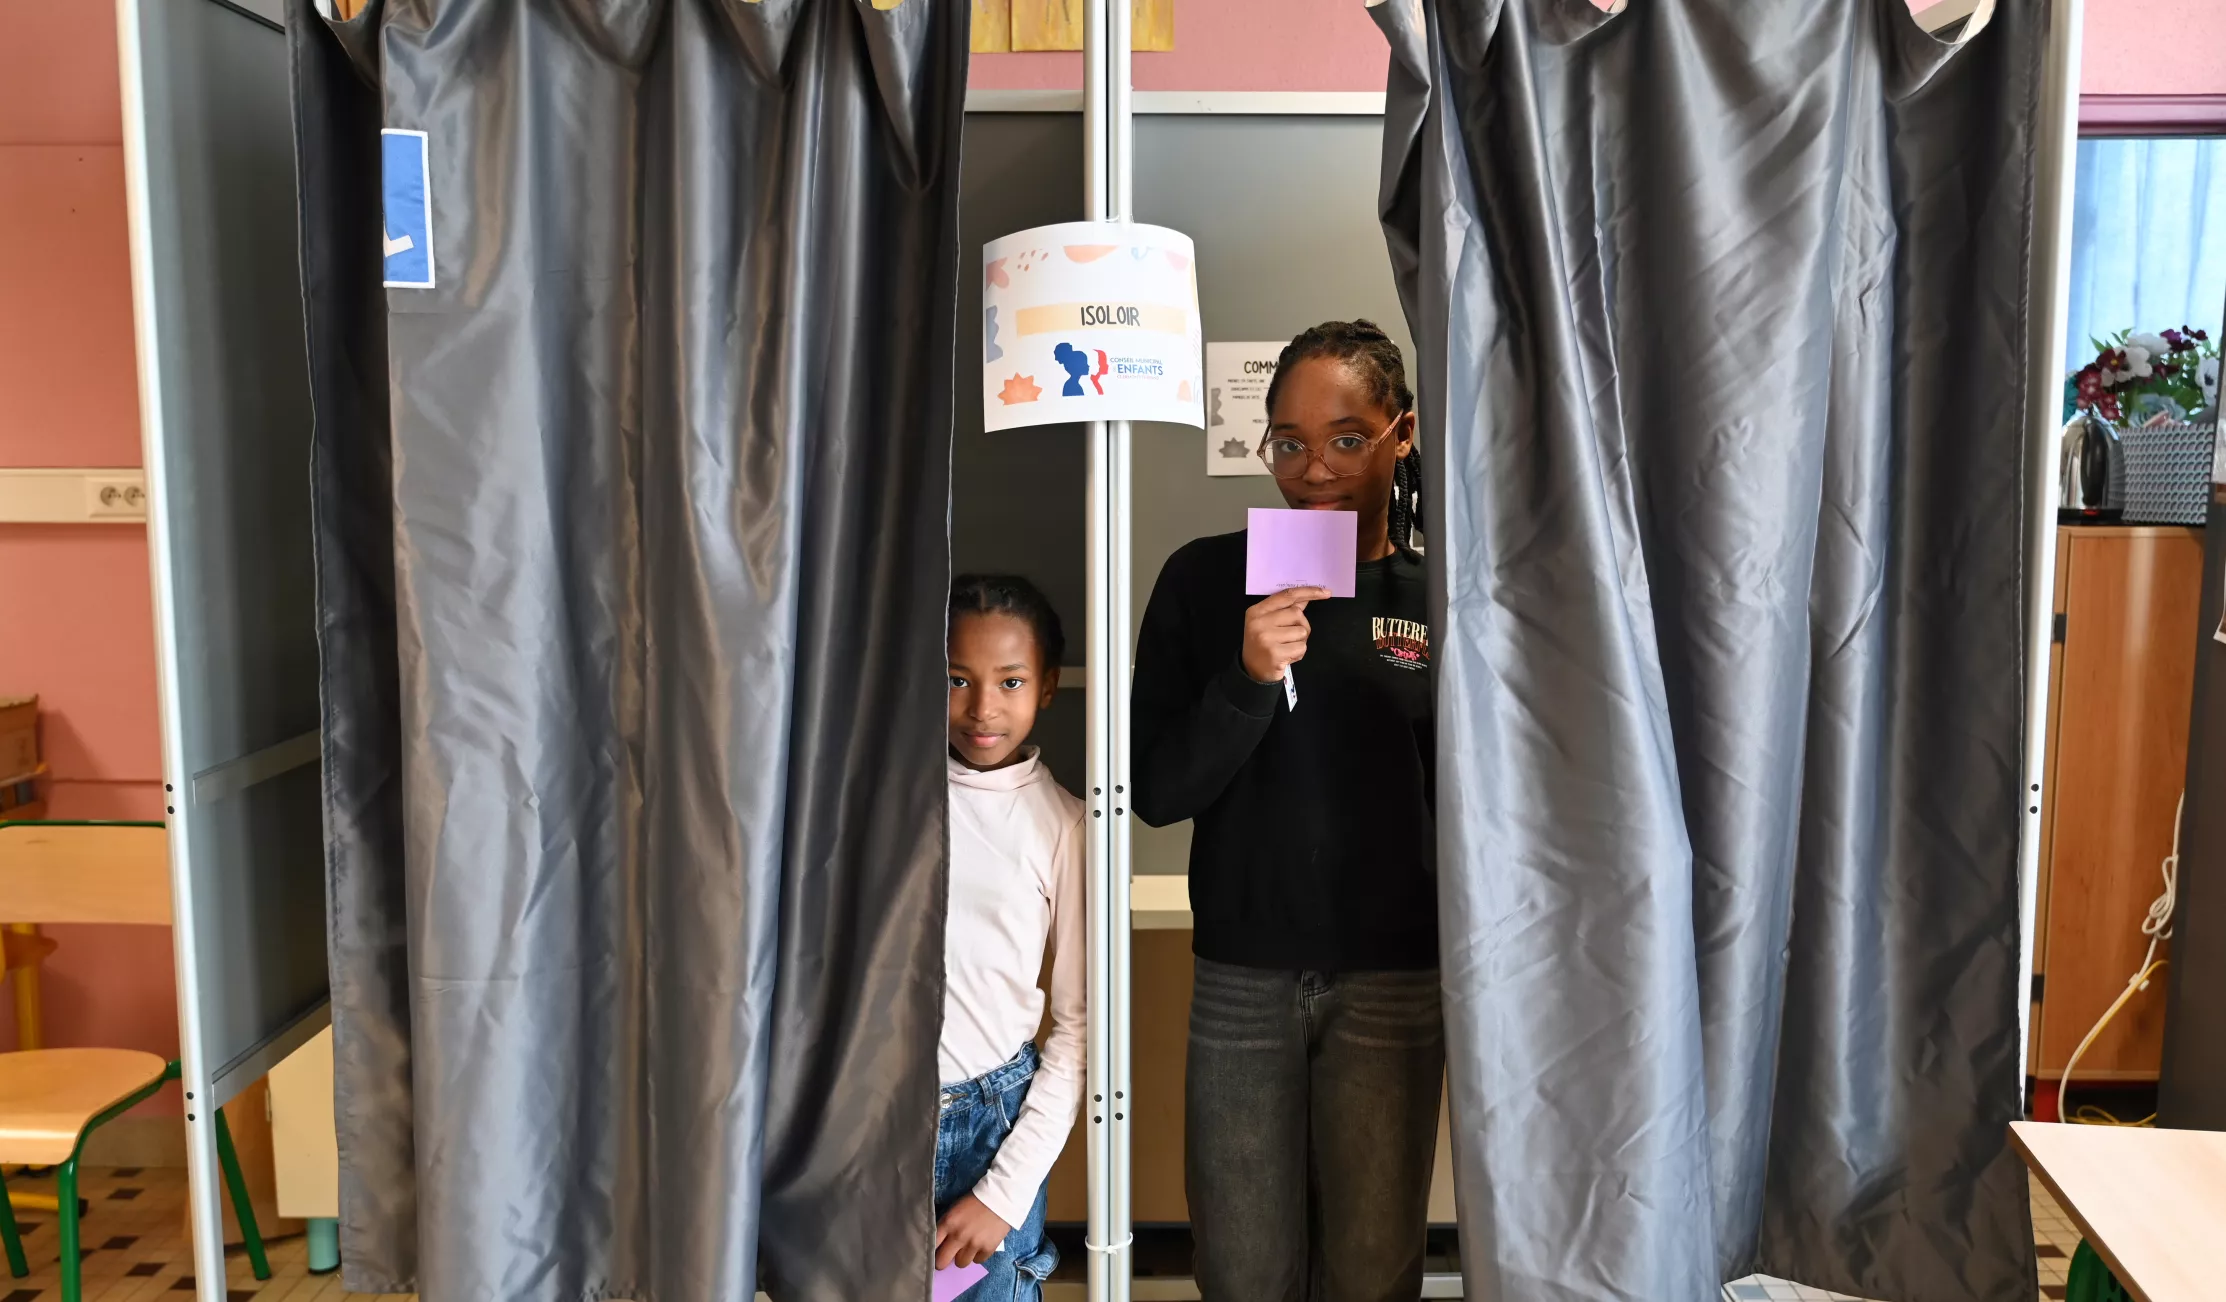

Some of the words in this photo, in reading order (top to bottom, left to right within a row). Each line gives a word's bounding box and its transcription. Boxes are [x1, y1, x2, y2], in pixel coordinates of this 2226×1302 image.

[1081, 305, 1140, 327] ISOLOIR
[1117, 364, 1164, 376] ENFANTS
[1372, 616, 1428, 646] BUTTERF
